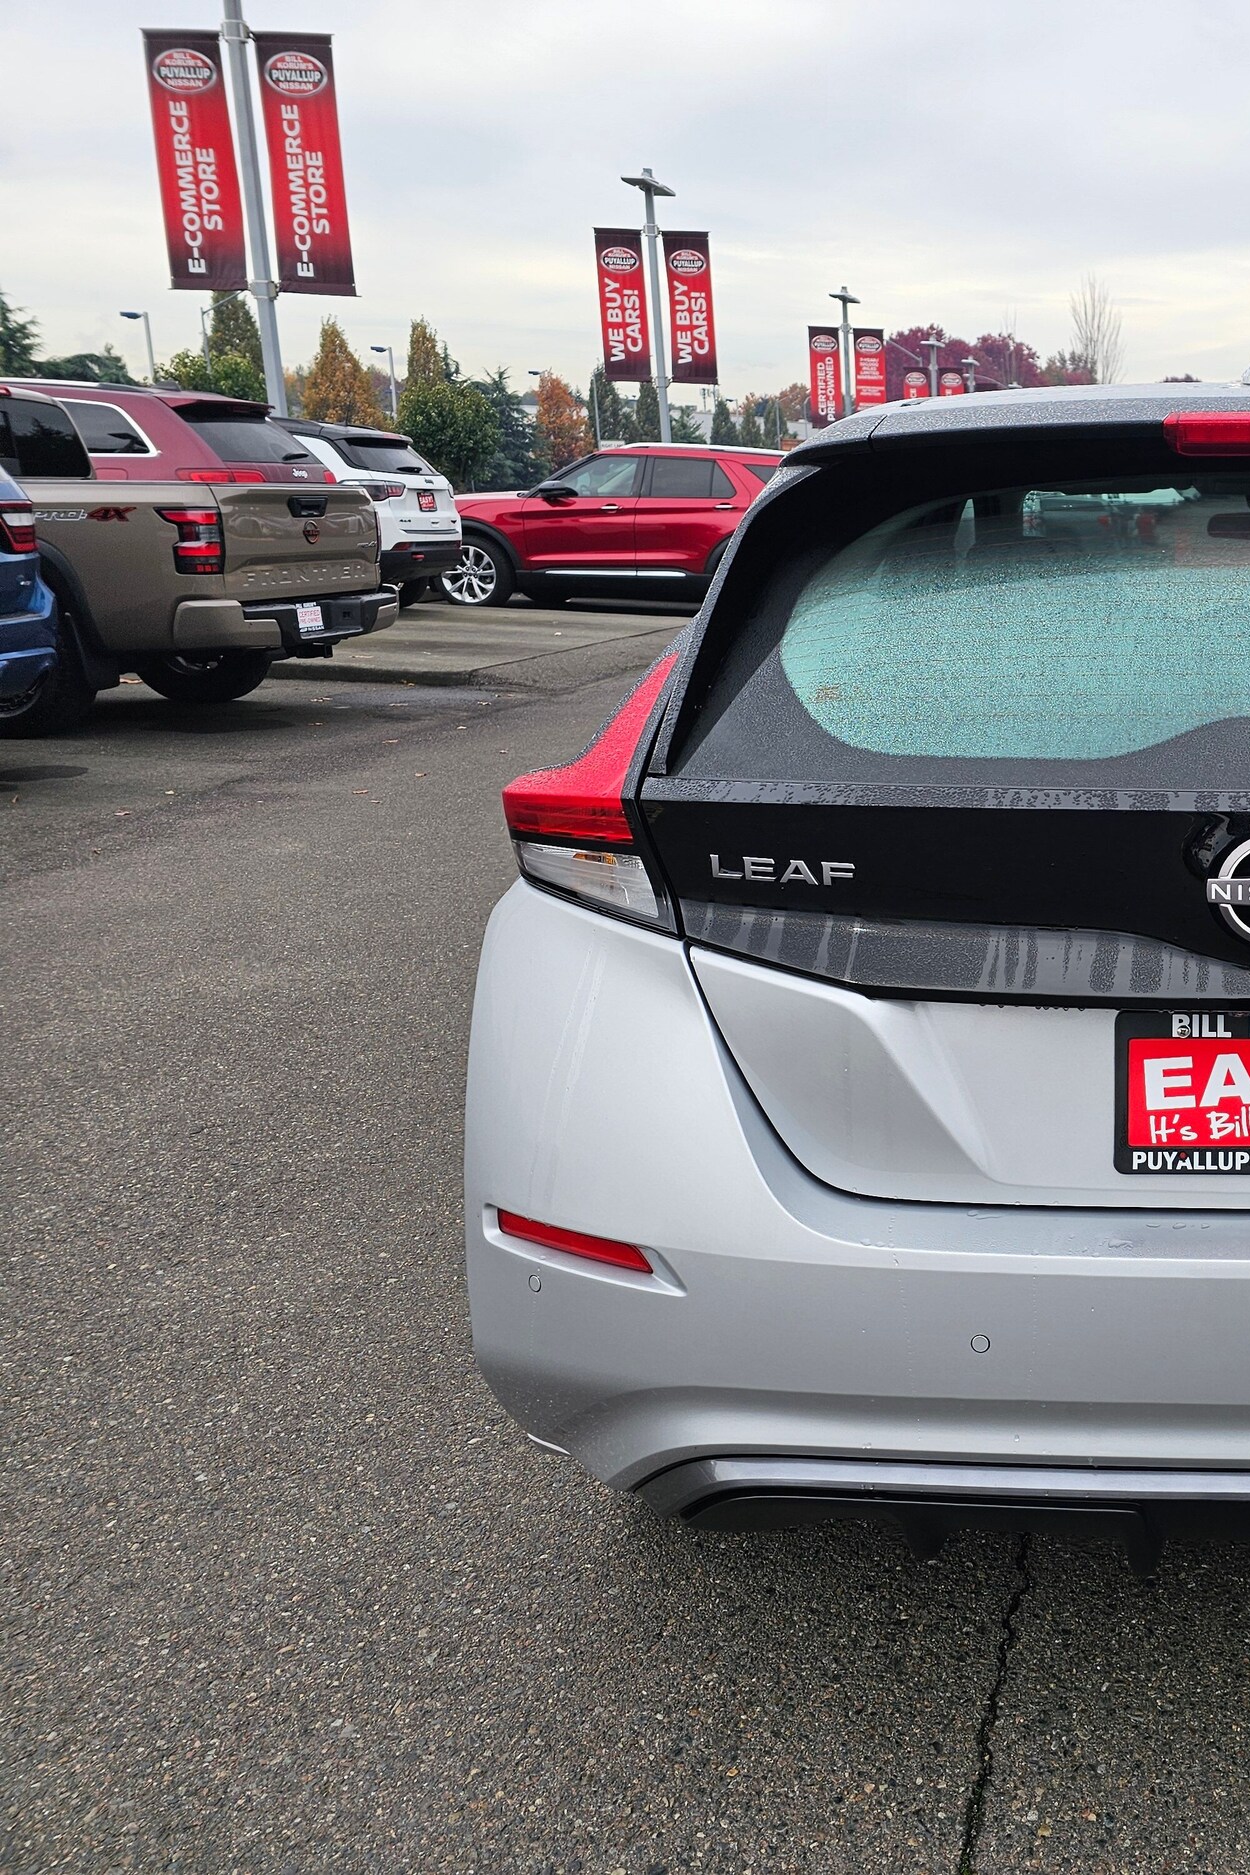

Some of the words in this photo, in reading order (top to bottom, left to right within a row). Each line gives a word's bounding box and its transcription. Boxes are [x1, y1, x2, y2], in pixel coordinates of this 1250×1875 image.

[160, 66, 211, 79] PUYALLUP
[173, 52, 192, 60] BILL
[285, 55, 303, 63] BILL
[167, 78, 203, 88] NISSAN
[271, 69, 321, 82] PUYALLUP
[279, 82, 313, 91] NISSAN
[169, 100, 207, 275] E-COMMERCE
[195, 147, 224, 231] STORE
[281, 104, 315, 277] E-COMMERCE
[305, 151, 330, 235] STORE
[604, 257, 636, 265] PUYALLUP
[673, 260, 703, 268] PUYALLUP
[604, 277, 623, 323] BUY
[673, 280, 690, 325] BUY
[623, 289, 643, 352] CARS!
[691, 292, 710, 355] CARS!
[608, 328, 626, 362] WE
[677, 330, 693, 364] WE
[817, 362, 827, 416] CERTIFIED
[825, 356, 836, 422] PRE-OWNED
[242, 564, 366, 588] FRONTIER
[709, 853, 856, 887] LEAF
[1171, 1013, 1232, 1038] BILL
[1150, 1114, 1198, 1144] It's
[1131, 1150, 1250, 1171] PUYALLUP
